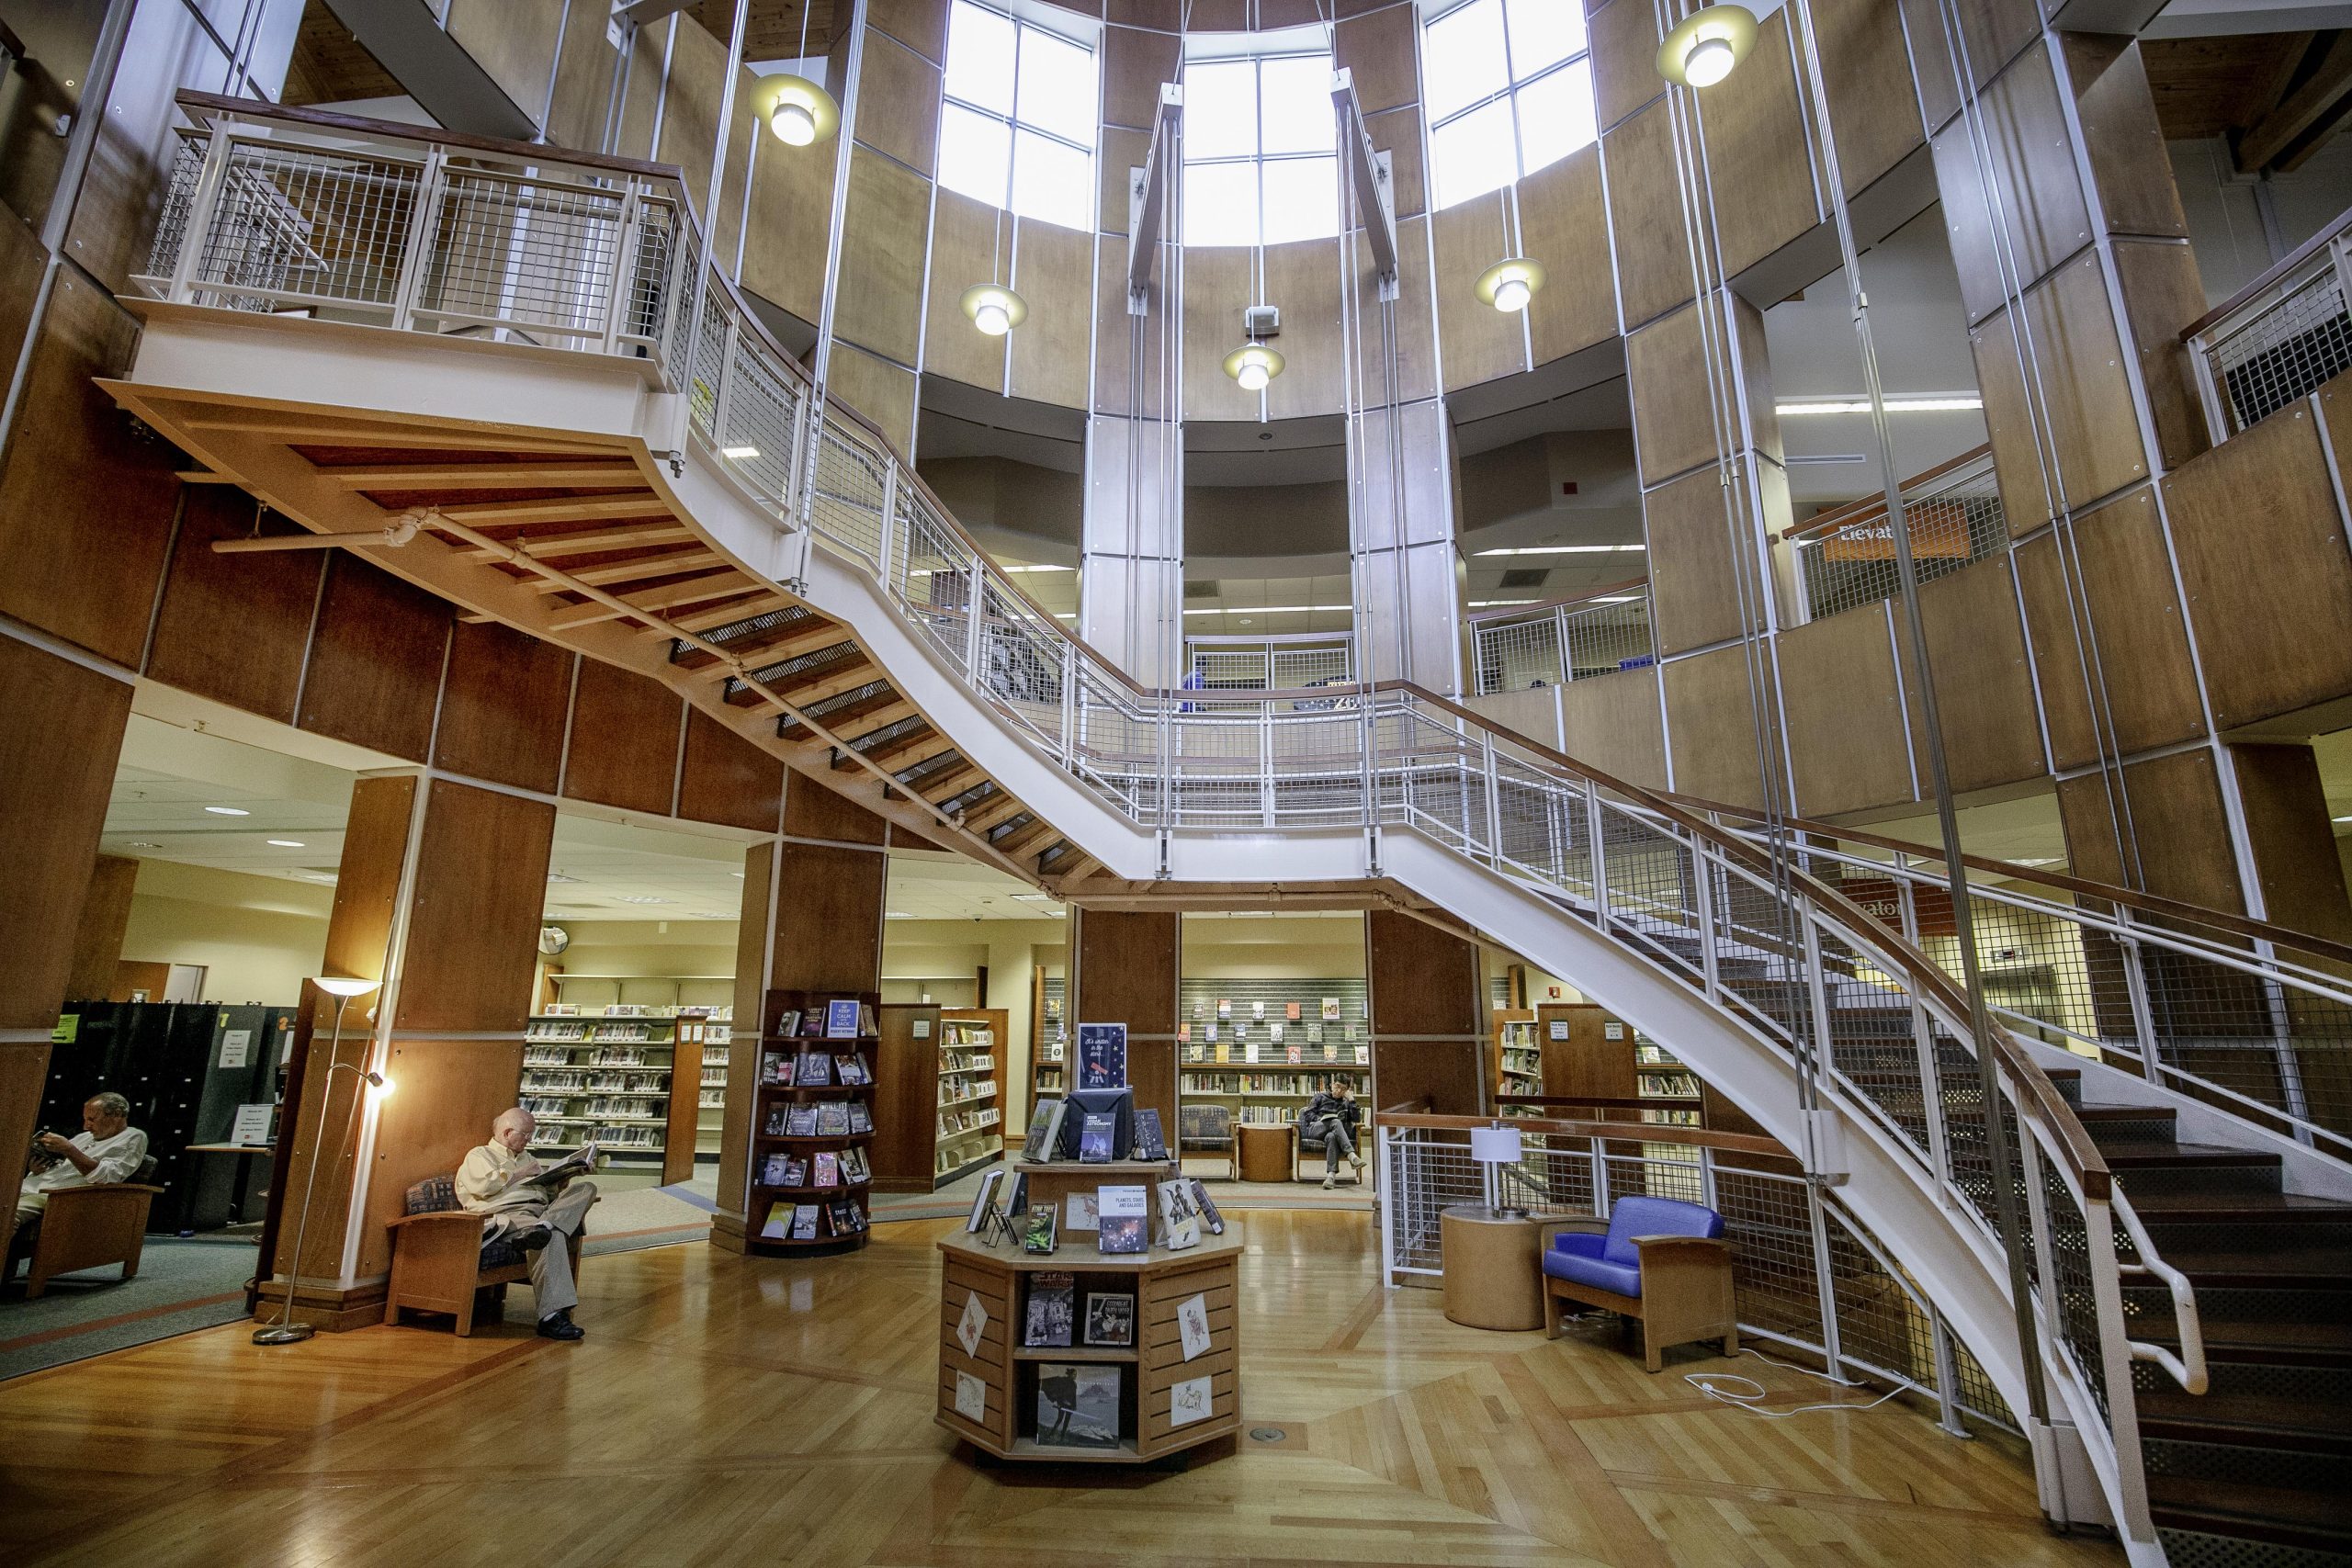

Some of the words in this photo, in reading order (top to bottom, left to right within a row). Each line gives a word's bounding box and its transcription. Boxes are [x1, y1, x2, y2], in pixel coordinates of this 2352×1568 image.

[1838, 524, 1911, 541] Elevat
[1031, 1204, 1044, 1213] STAR
[1043, 1204, 1055, 1213] TREK
[1038, 1271, 1074, 1280] STAR
